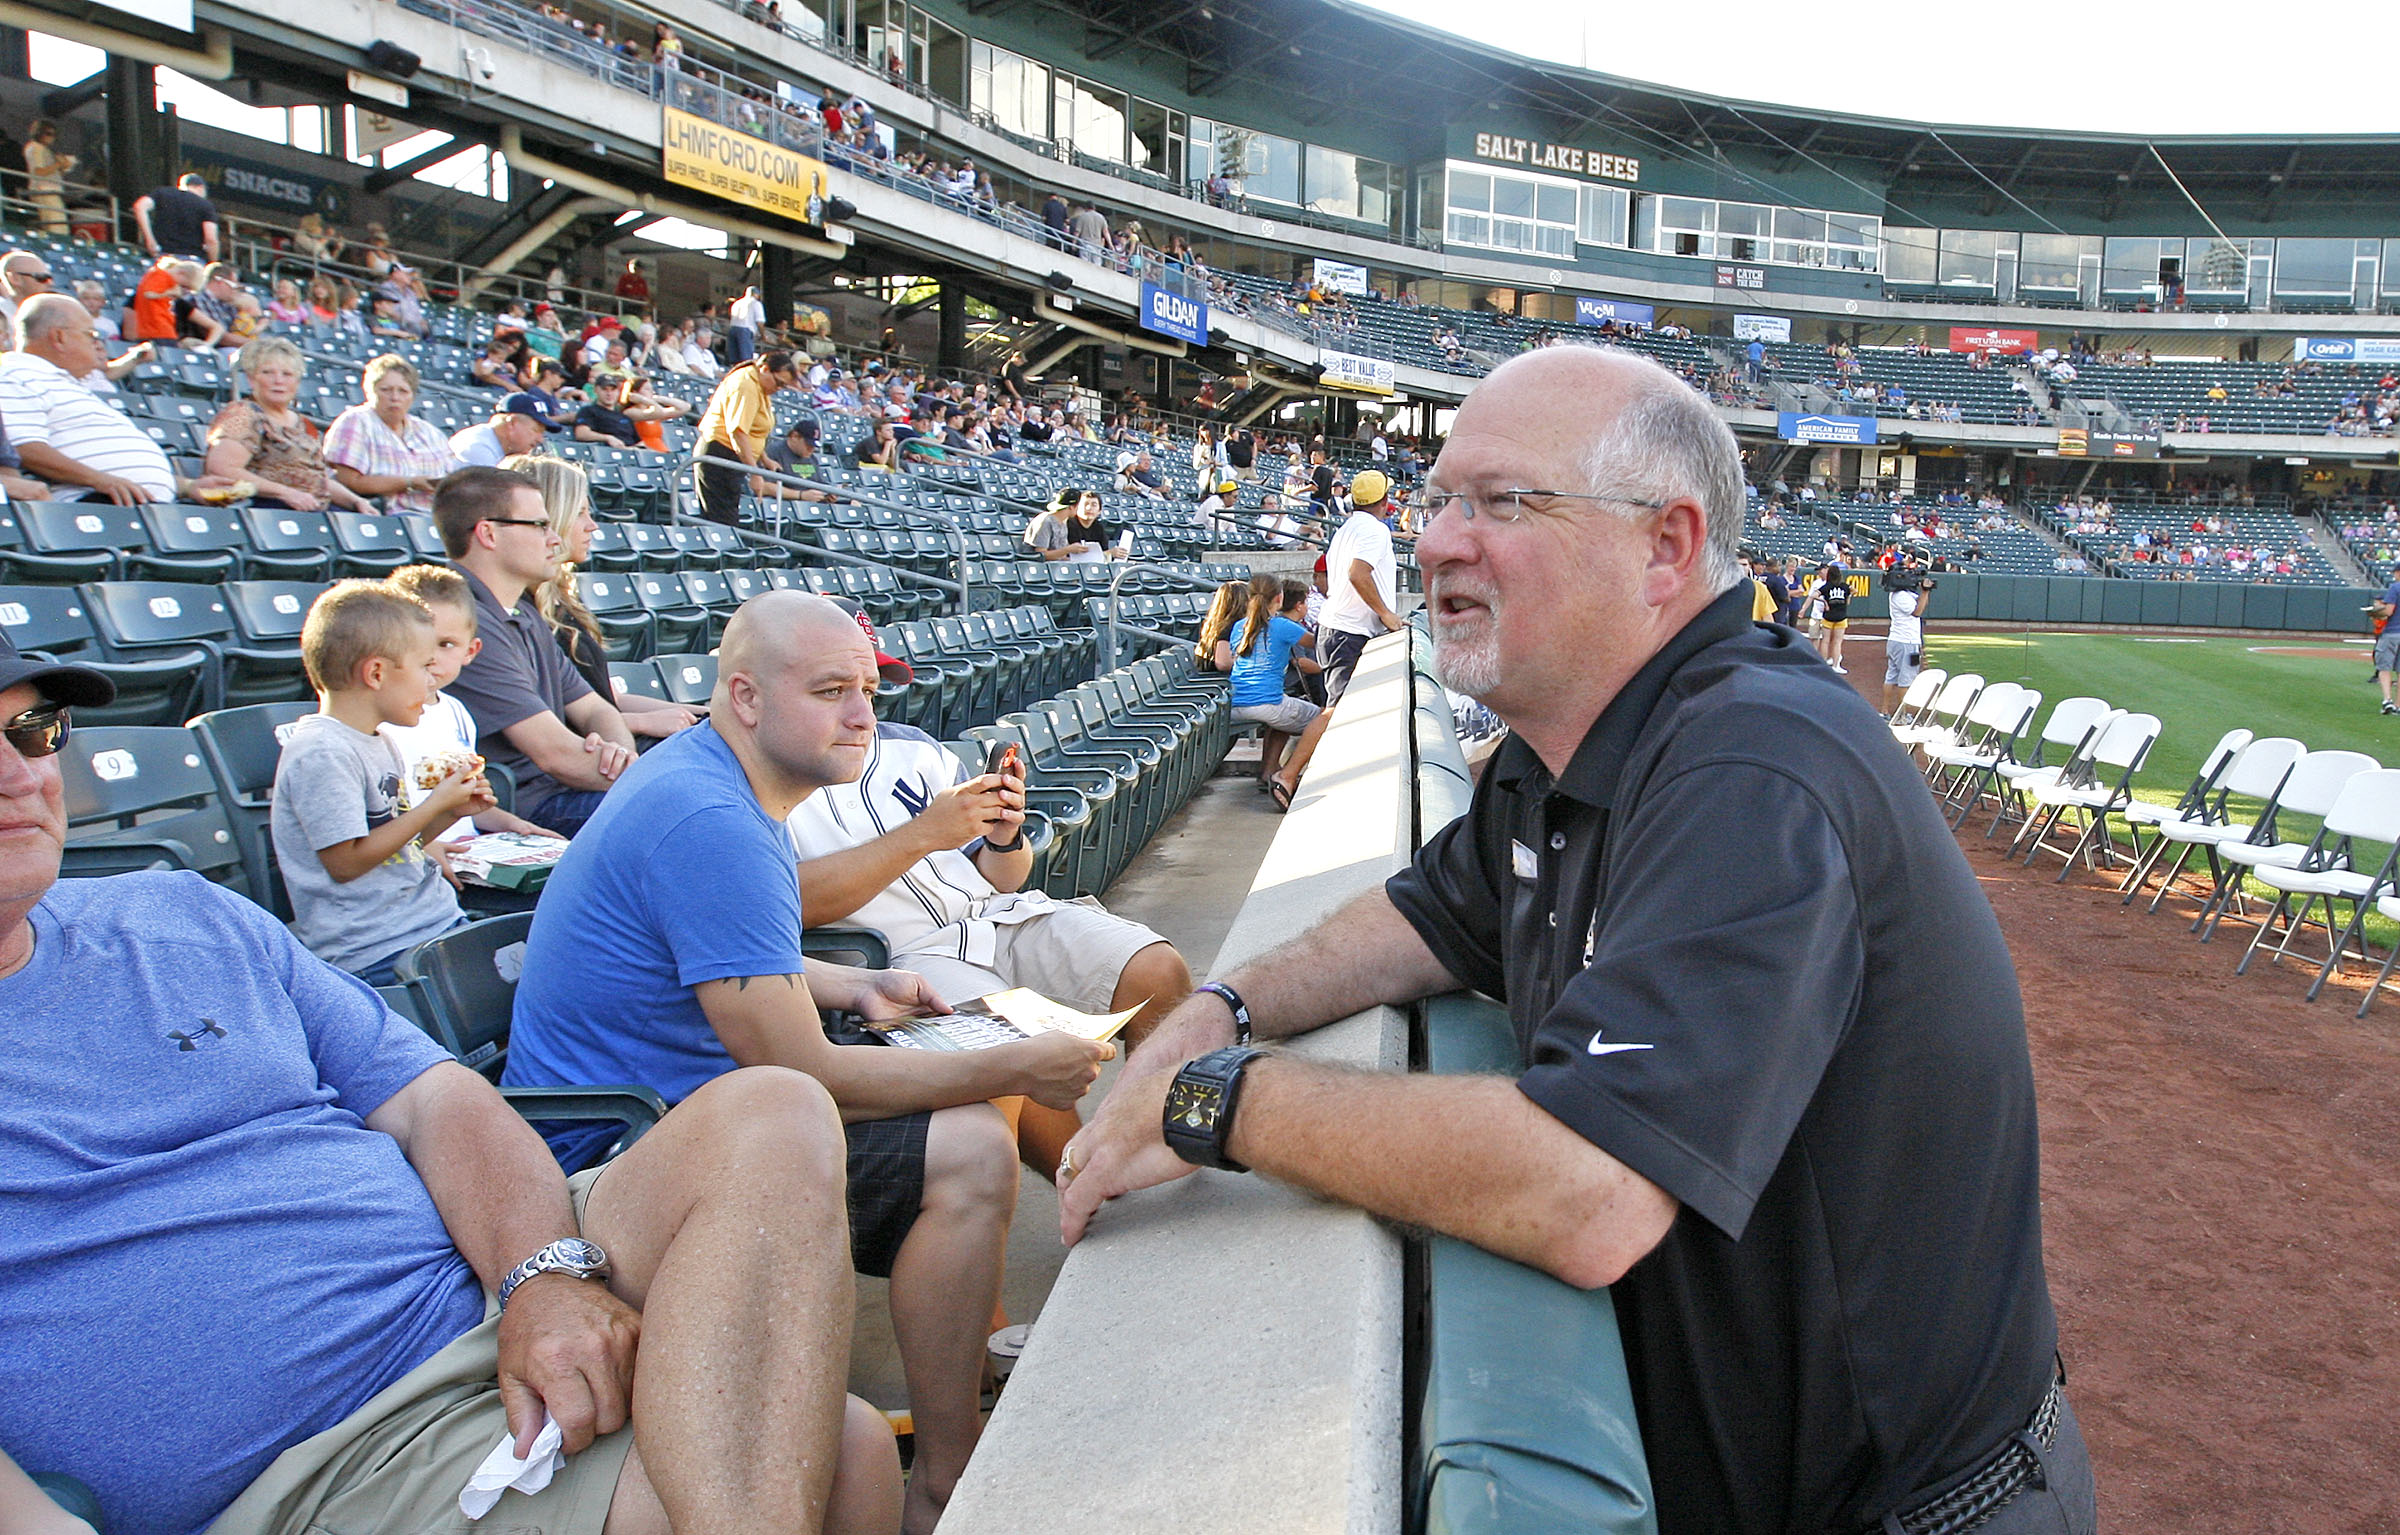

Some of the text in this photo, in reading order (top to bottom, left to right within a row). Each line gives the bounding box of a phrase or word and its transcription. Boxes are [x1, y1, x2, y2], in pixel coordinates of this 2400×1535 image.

[667, 115, 800, 190] LHMFORD.COM
[1476, 132, 1639, 182] SALT LAKE BEES
[224, 166, 312, 205] SNACKS
[710, 172, 729, 190] SUPER
[762, 189, 779, 206] SUPER
[1737, 268, 1764, 280] CATCH
[1153, 291, 1199, 329] GILDAN
[1578, 301, 1615, 319] VLCM
[1965, 337, 1982, 345] FIRST
[1982, 337, 2001, 346] UTAH
[2002, 339, 2021, 347] BANK
[2316, 343, 2346, 355] Orbit
[1341, 357, 1357, 375] BEST
[1358, 361, 1376, 378] VALUE
[1797, 424, 1860, 435] AMERICAN FAMILY
[1801, 432, 1855, 441] INSURANCE
[2093, 432, 2158, 442] Made Fresh For You
[2, 606, 20, 621] 11
[106, 756, 121, 776] 9
